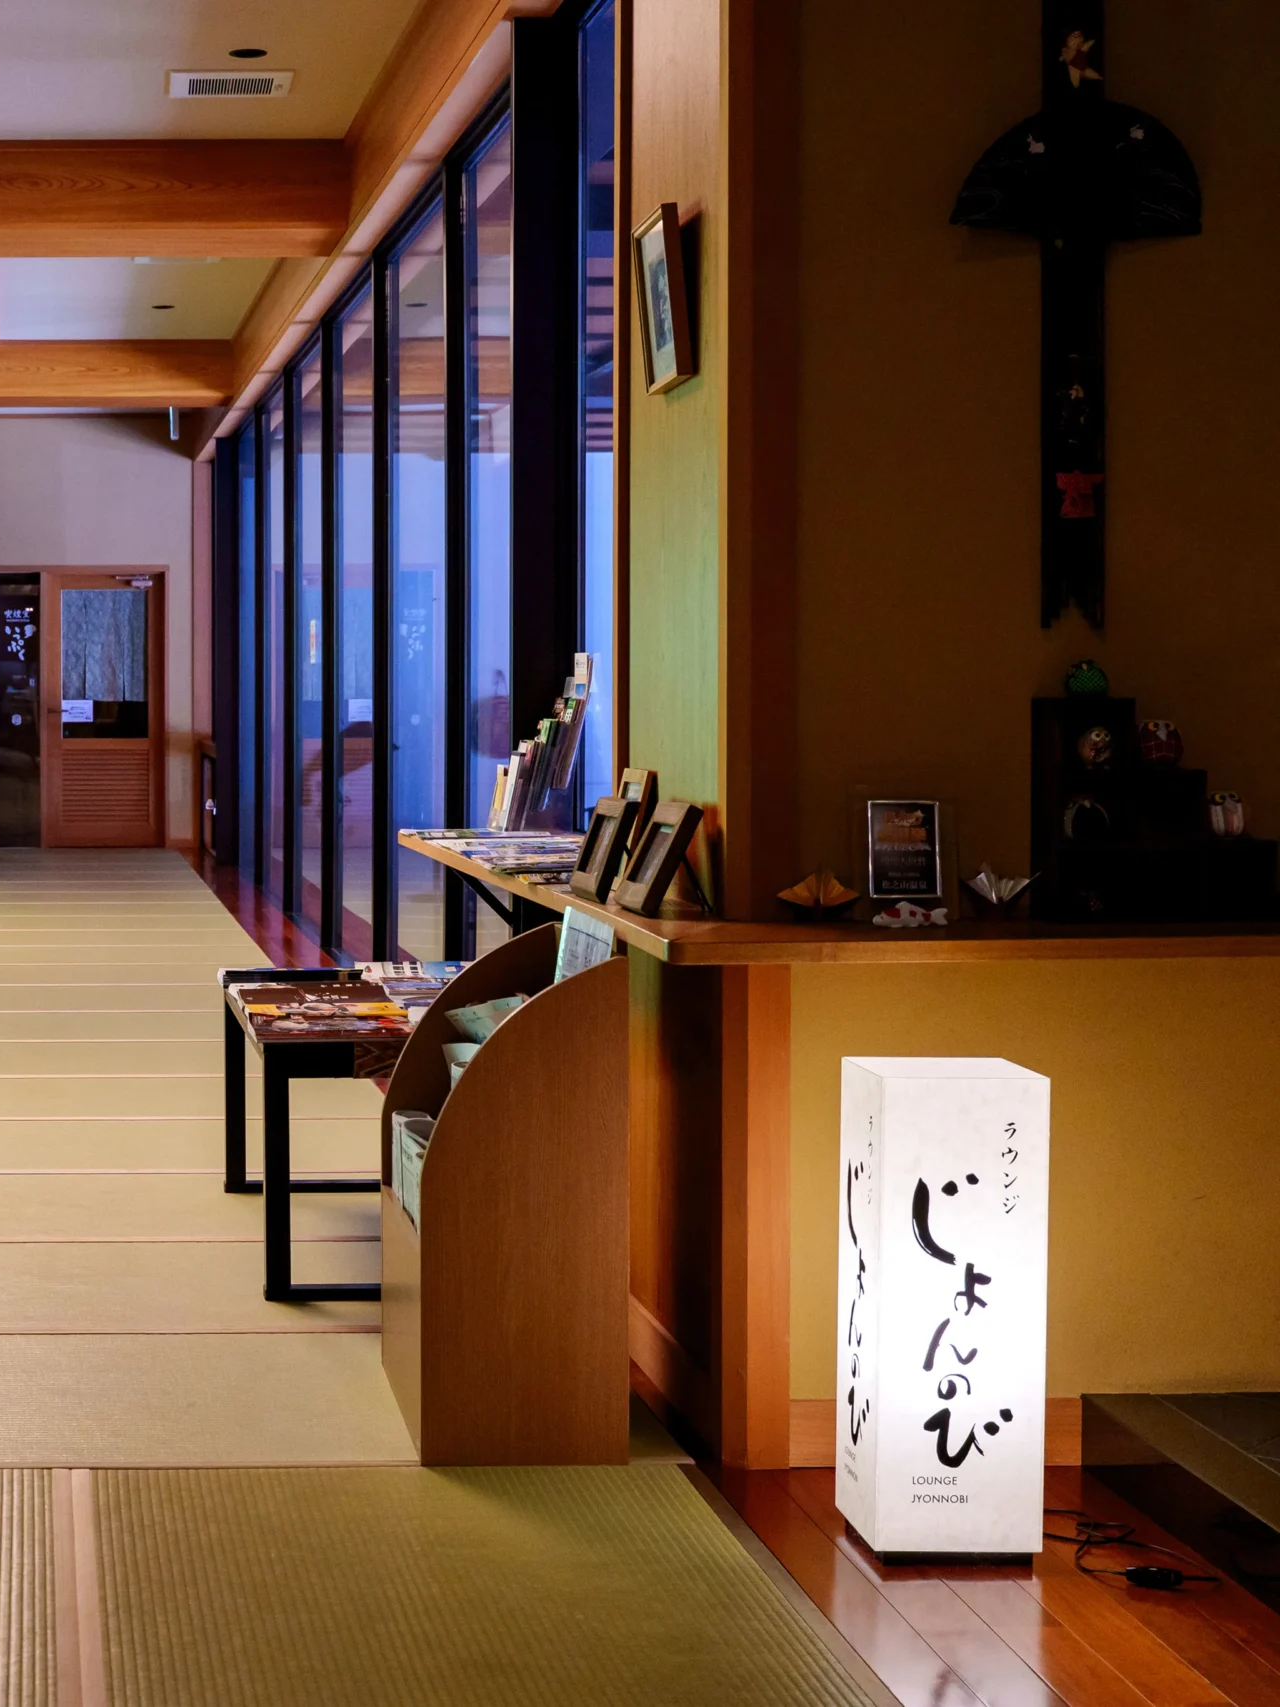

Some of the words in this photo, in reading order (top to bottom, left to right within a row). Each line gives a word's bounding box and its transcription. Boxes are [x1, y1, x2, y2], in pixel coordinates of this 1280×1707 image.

[5, 625, 26, 661] いっぷく
[1000, 1121, 1019, 1215] ラウンジ
[912, 1173, 1013, 1468] じょんのび
[911, 1476, 958, 1486] LOUNGE
[911, 1494, 969, 1504] JYONNOBI
